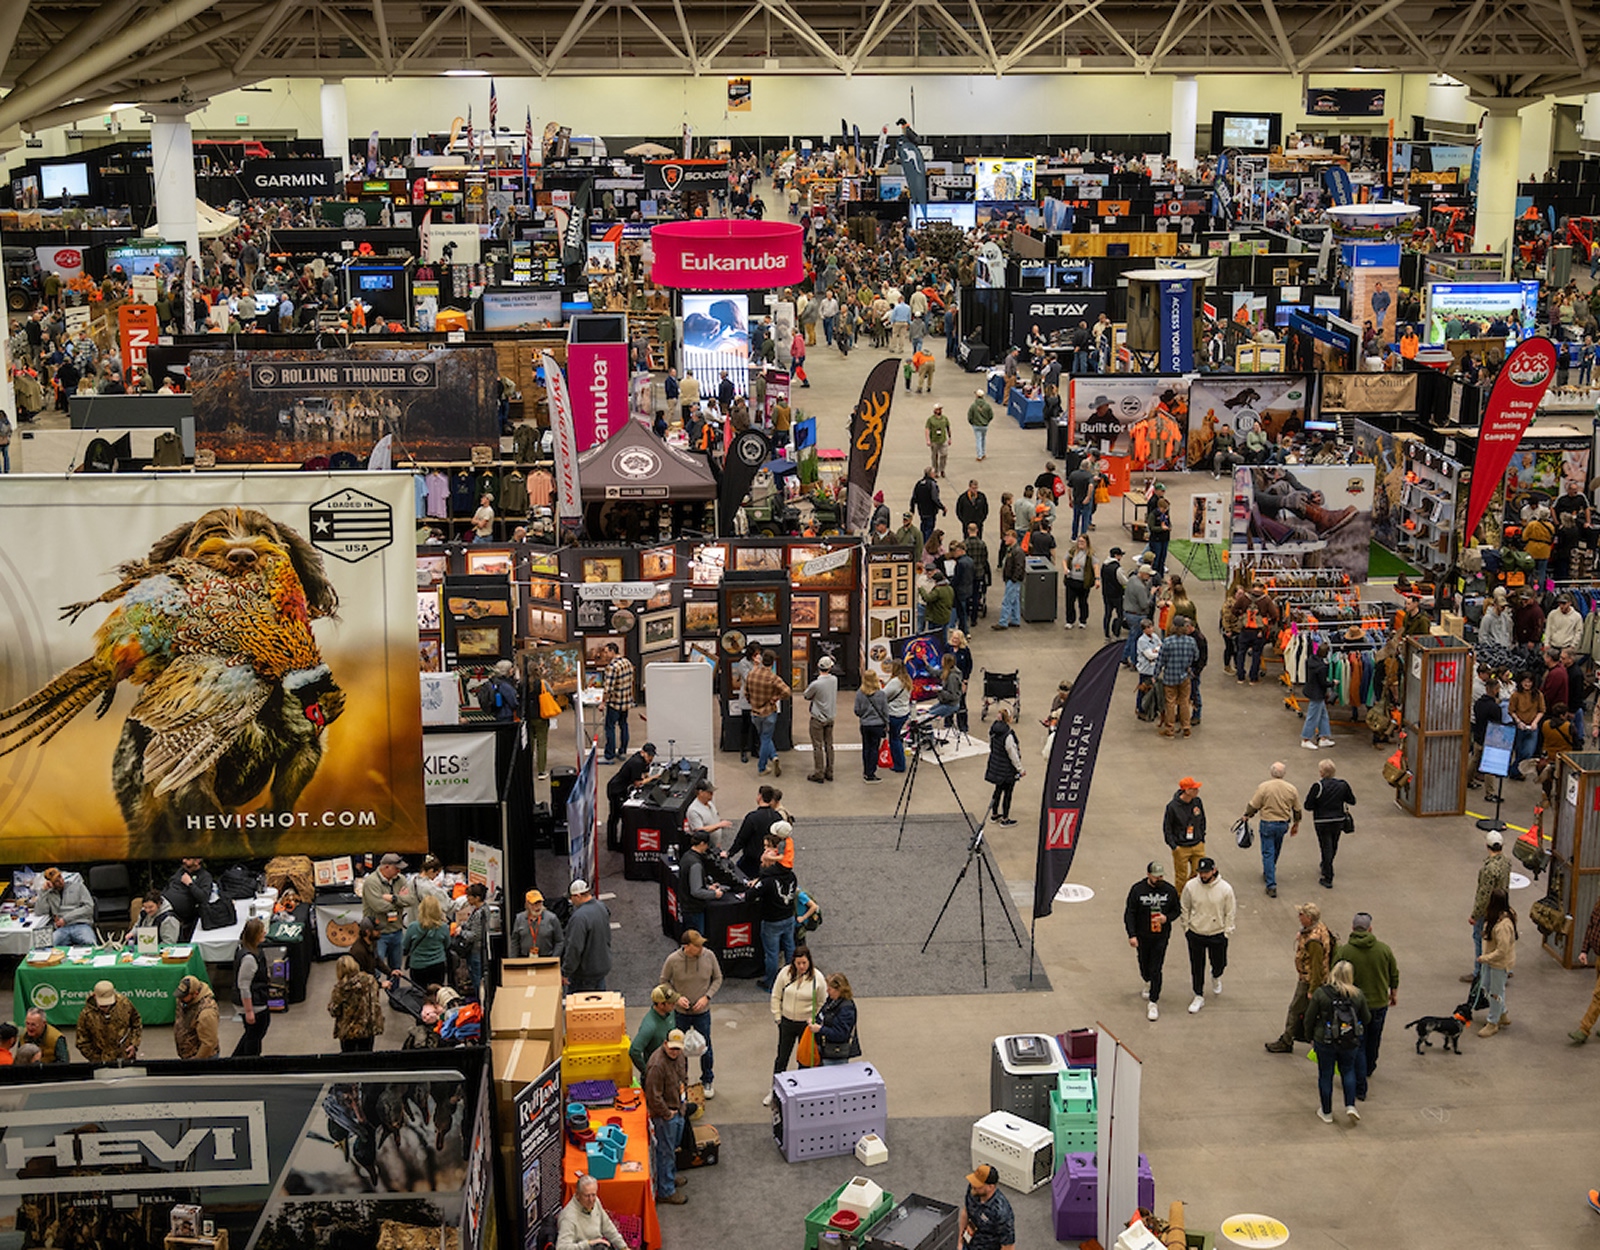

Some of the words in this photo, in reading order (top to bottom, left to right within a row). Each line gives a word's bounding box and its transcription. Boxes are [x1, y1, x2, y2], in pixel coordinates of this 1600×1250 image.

[255, 173, 325, 187] GARMIN
[566, 206, 581, 248] HUNT
[681, 252, 787, 271] Eukanuba
[1029, 303, 1088, 316] RETAY
[1171, 296, 1180, 330] ACCESS
[1171, 330, 1181, 356] YOUR
[280, 366, 338, 384] ROLLING
[342, 365, 406, 383] THUNDER
[590, 360, 608, 444] anuba
[1510, 401, 1533, 409] Skiing
[1500, 411, 1527, 420] Fishing
[1080, 422, 1107, 433] Built
[1109, 422, 1126, 433] for
[1492, 422, 1521, 430] Hunting
[552, 373, 573, 505] WINCHESTER
[1484, 433, 1516, 442] Camping
[345, 544, 369, 552] USA
[423, 754, 460, 775] KIES
[1056, 714, 1084, 801] SILENCER
[1067, 722, 1093, 801] CENTRAL
[426, 778, 469, 786] VATION
[186, 811, 376, 829] HEVISHOT.COM
[135, 989, 168, 998] Works
[5, 1126, 237, 1170] HEVI
